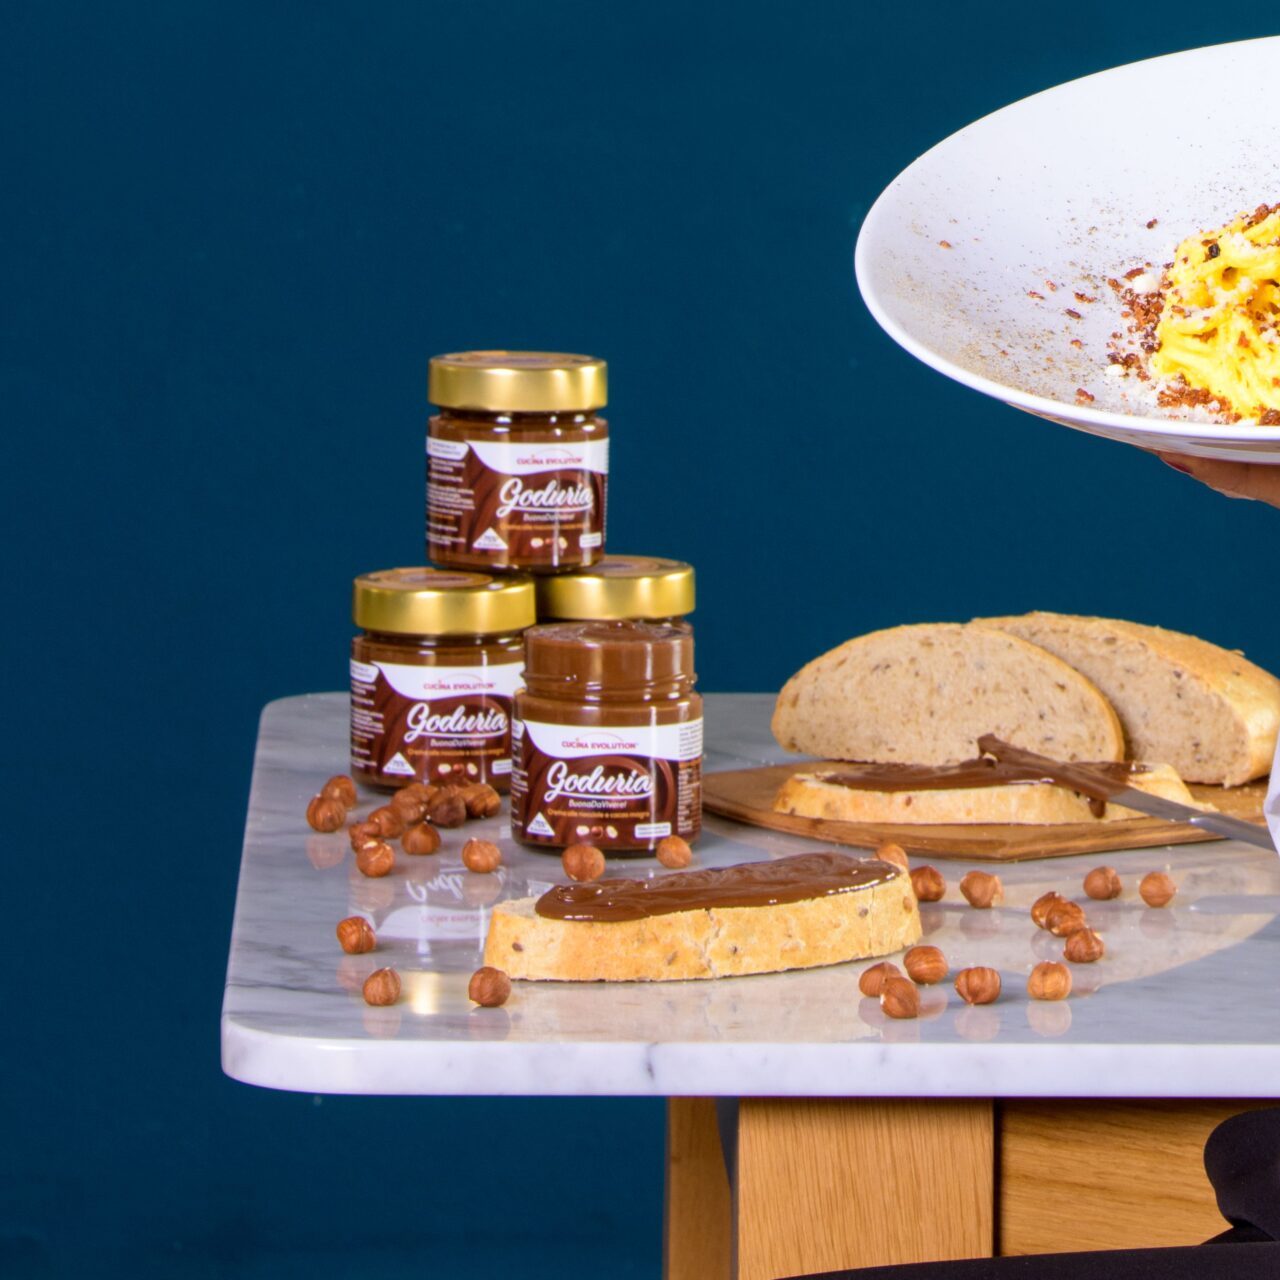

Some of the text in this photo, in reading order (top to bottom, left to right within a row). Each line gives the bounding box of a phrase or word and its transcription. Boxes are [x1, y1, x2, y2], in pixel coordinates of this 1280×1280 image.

[496, 478, 594, 518] Goduria
[404, 702, 508, 743] Goduria
[561, 740, 636, 749] CUCINA EVOLUTION
[544, 761, 652, 802] Goduria
